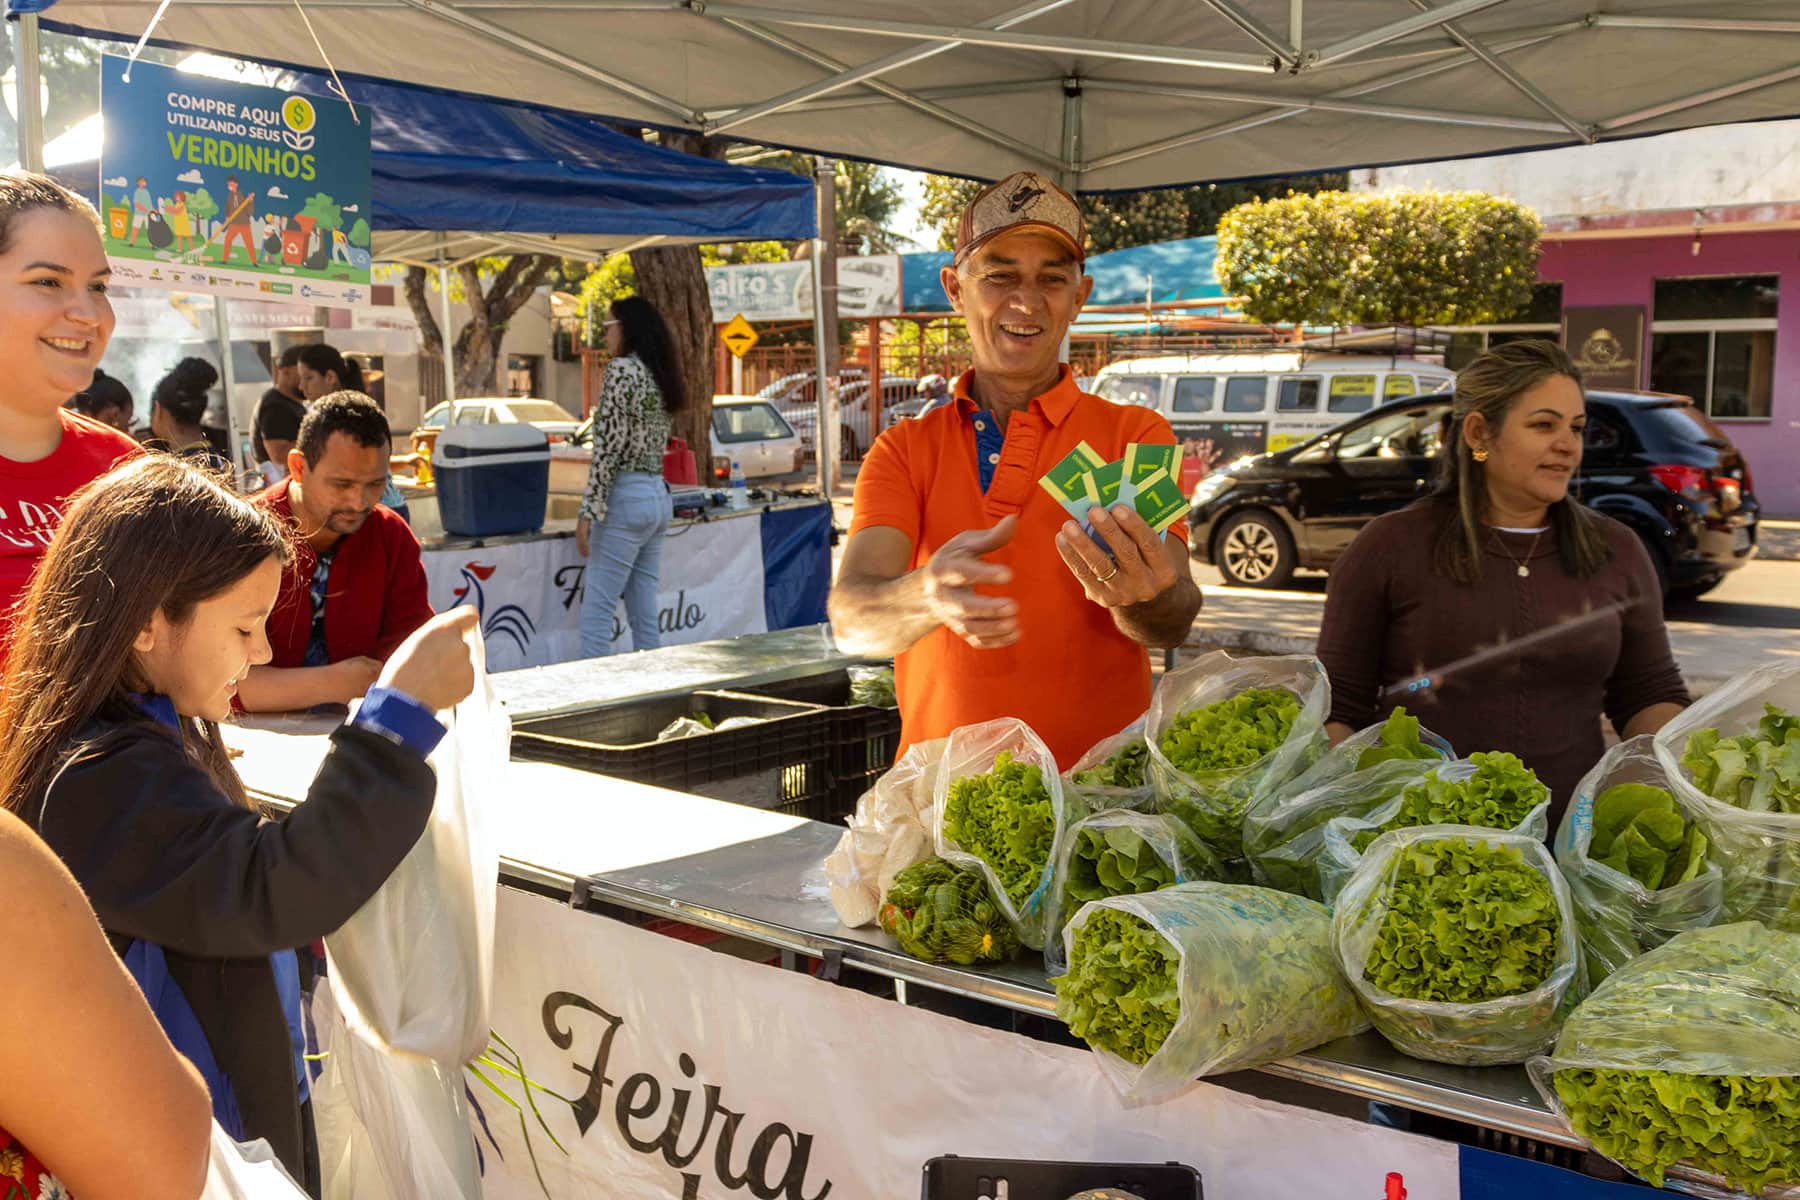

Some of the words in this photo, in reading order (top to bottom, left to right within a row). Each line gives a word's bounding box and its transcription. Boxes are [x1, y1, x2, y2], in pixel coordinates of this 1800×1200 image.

[167, 92, 236, 117] COMPRE
[240, 106, 280, 127] AQUI
[167, 111, 246, 136] UTILIZANDO
[249, 126, 281, 142] SEUS
[166, 131, 317, 181] VERDINHOS
[1063, 471, 1082, 491] 1
[1146, 490, 1164, 508] 1
[541, 990, 833, 1200] Feira
